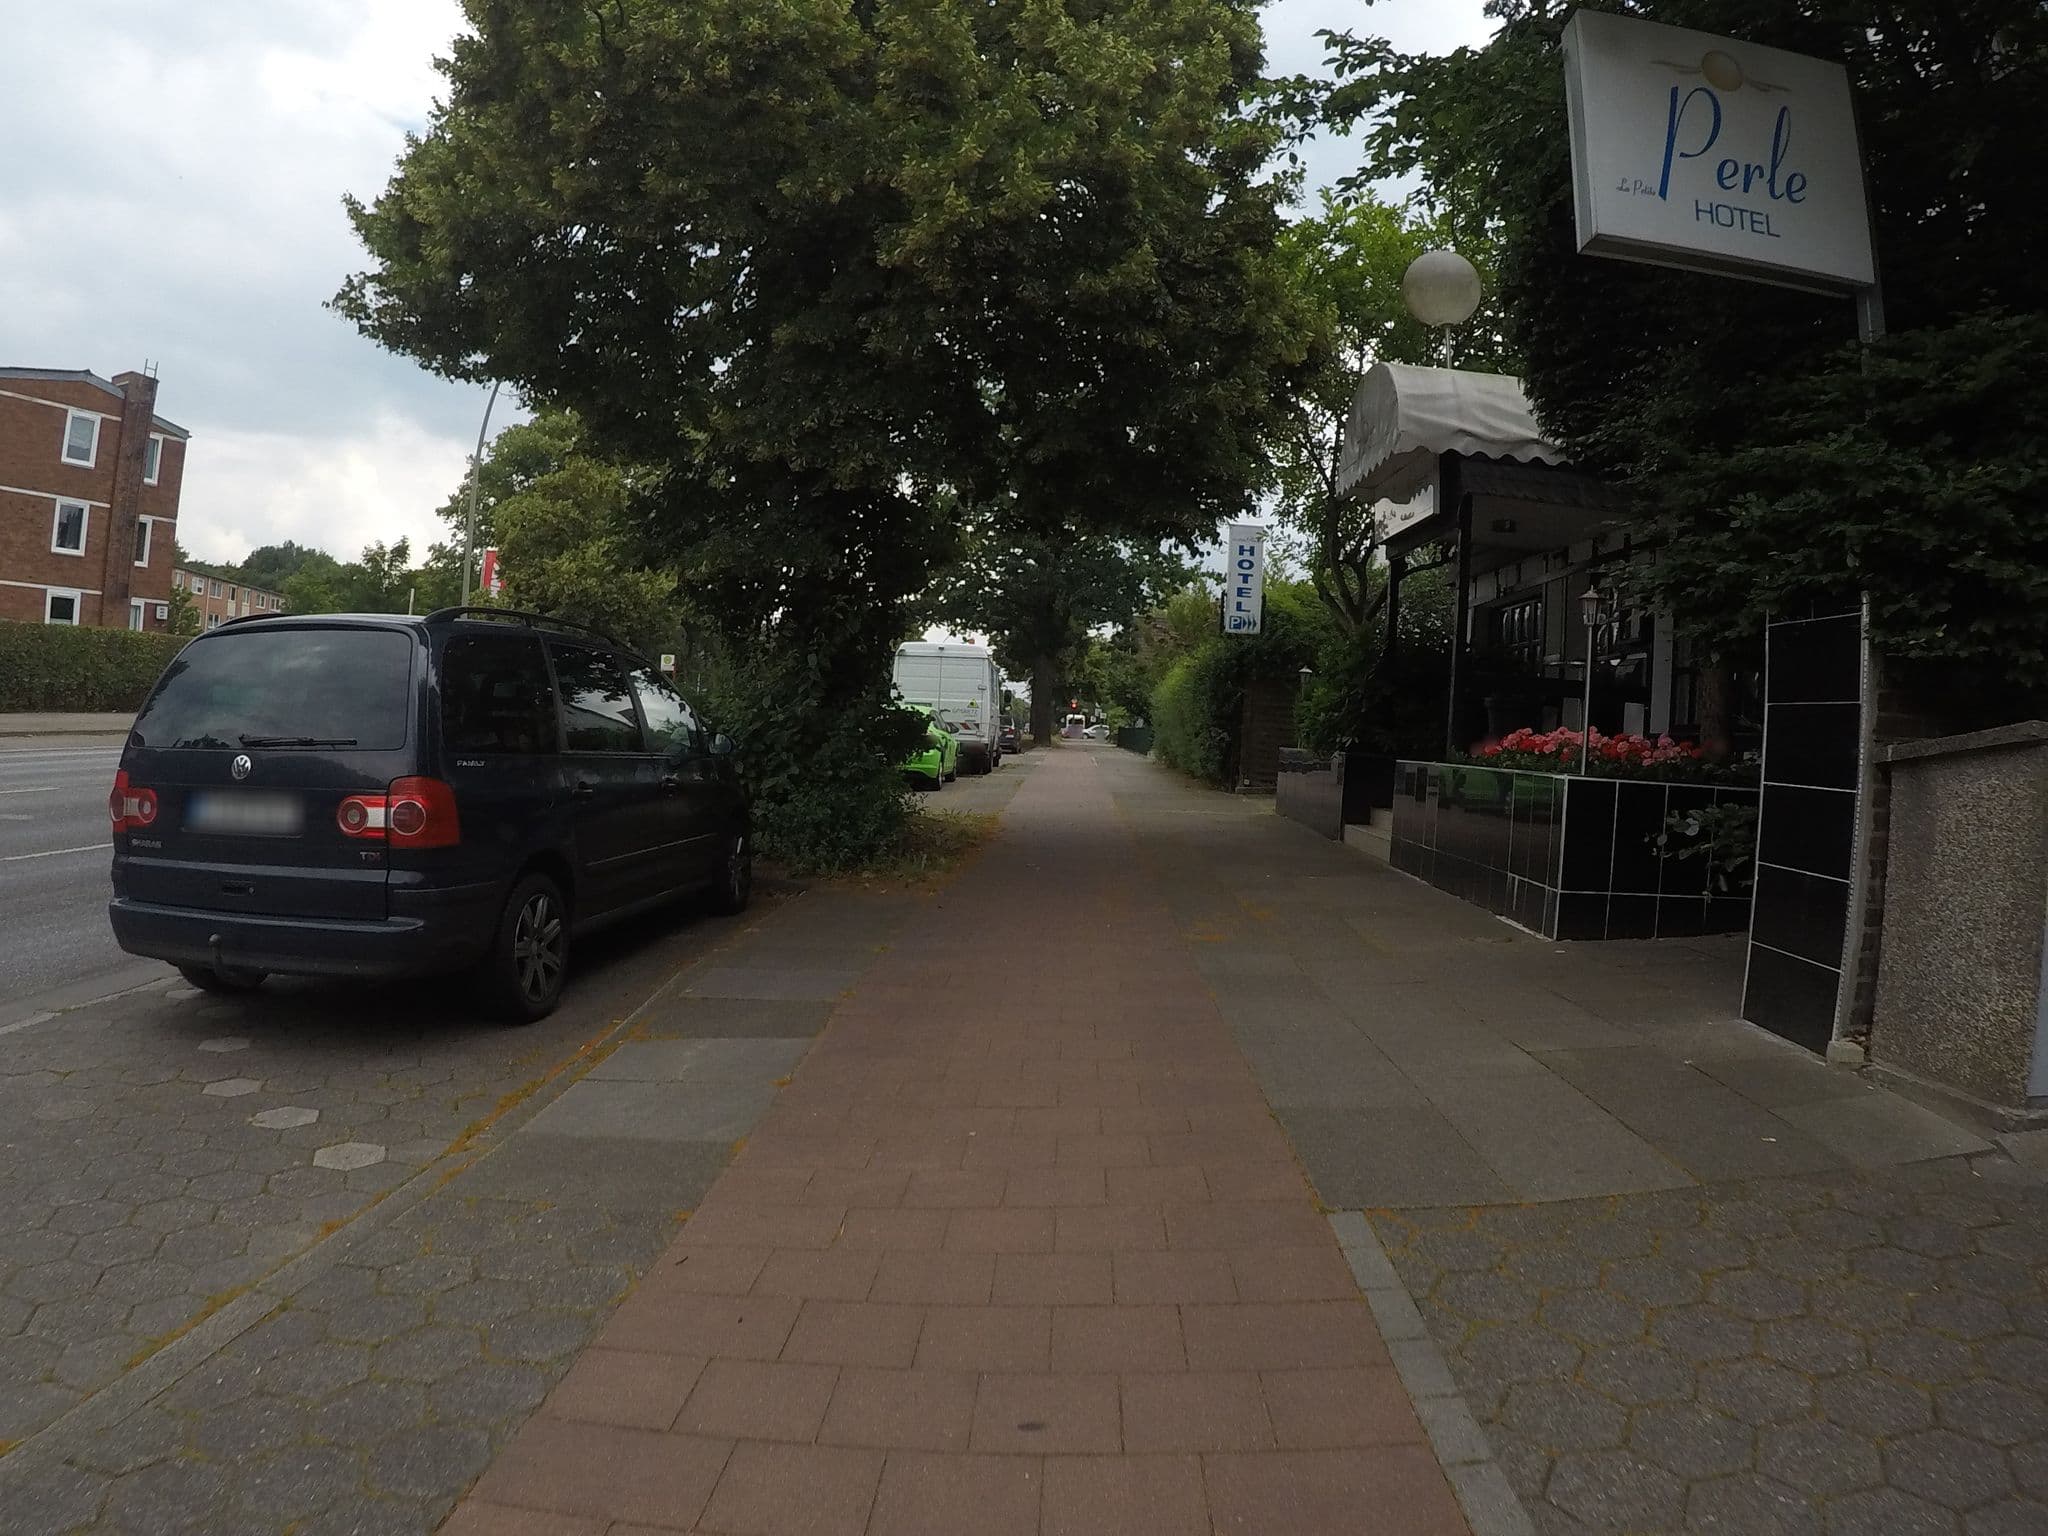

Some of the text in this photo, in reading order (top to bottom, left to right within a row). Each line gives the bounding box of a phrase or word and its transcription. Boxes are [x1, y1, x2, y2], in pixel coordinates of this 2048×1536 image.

[1658, 86, 1807, 204] Perle
[1695, 200, 1781, 238] HOTEL
[1235, 544, 1256, 613] HOTEL
